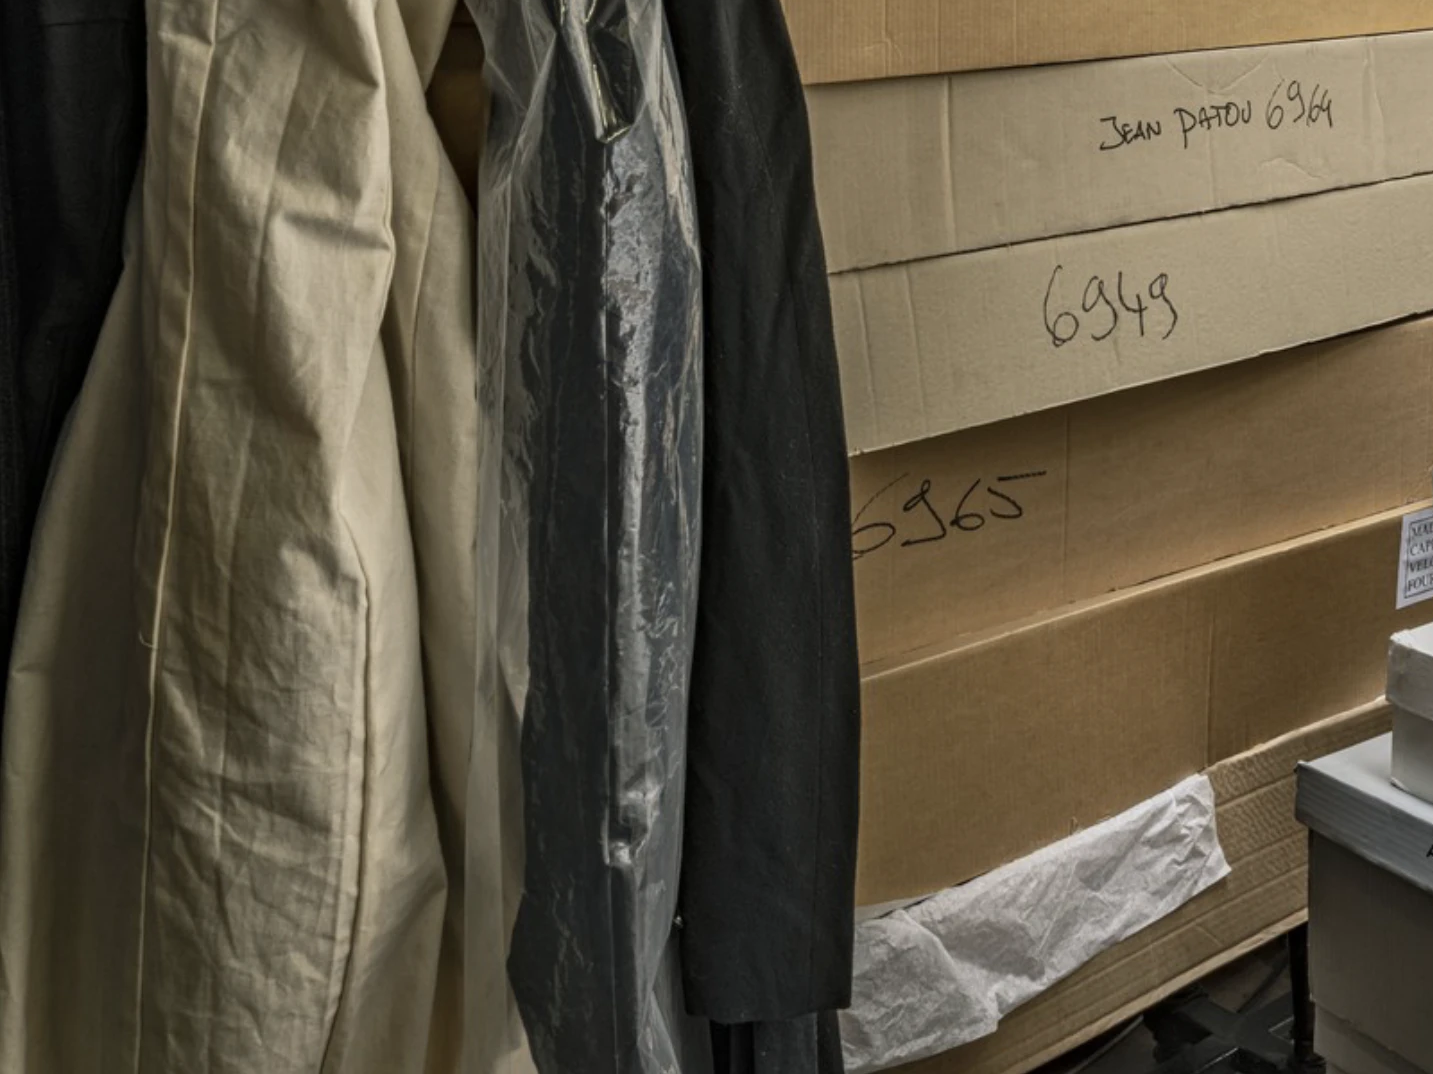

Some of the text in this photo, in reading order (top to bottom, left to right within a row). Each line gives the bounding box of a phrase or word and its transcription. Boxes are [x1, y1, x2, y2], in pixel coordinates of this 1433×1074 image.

[1099, 77, 1334, 151] JEAN PATOU 6964
[1042, 264, 1179, 348] 6949
[851, 470, 1048, 562] 6965
